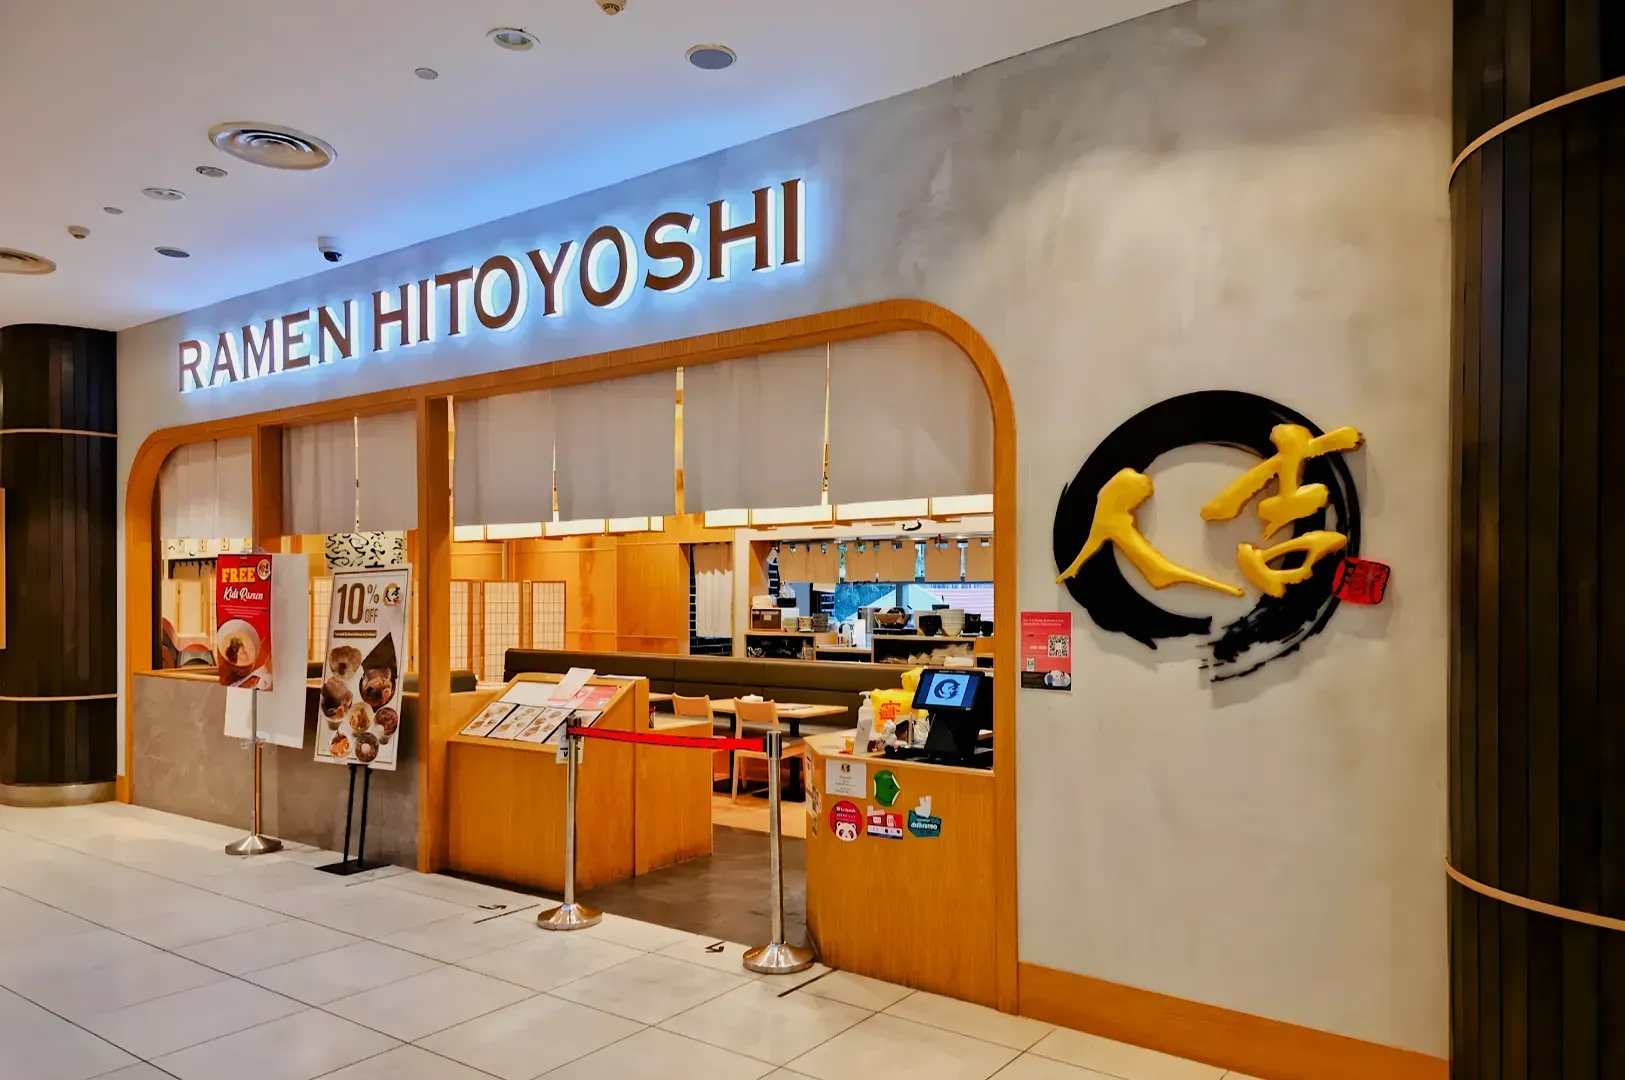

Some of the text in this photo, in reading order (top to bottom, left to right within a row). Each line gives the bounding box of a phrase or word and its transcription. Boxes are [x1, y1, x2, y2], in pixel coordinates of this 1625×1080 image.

[178, 177, 804, 393] RAMEN HITOYOSHI
[221, 567, 256, 583] FREE
[223, 586, 264, 601] Kids Ramen
[337, 582, 380, 625] 10%
[364, 608, 379, 624] OFF
